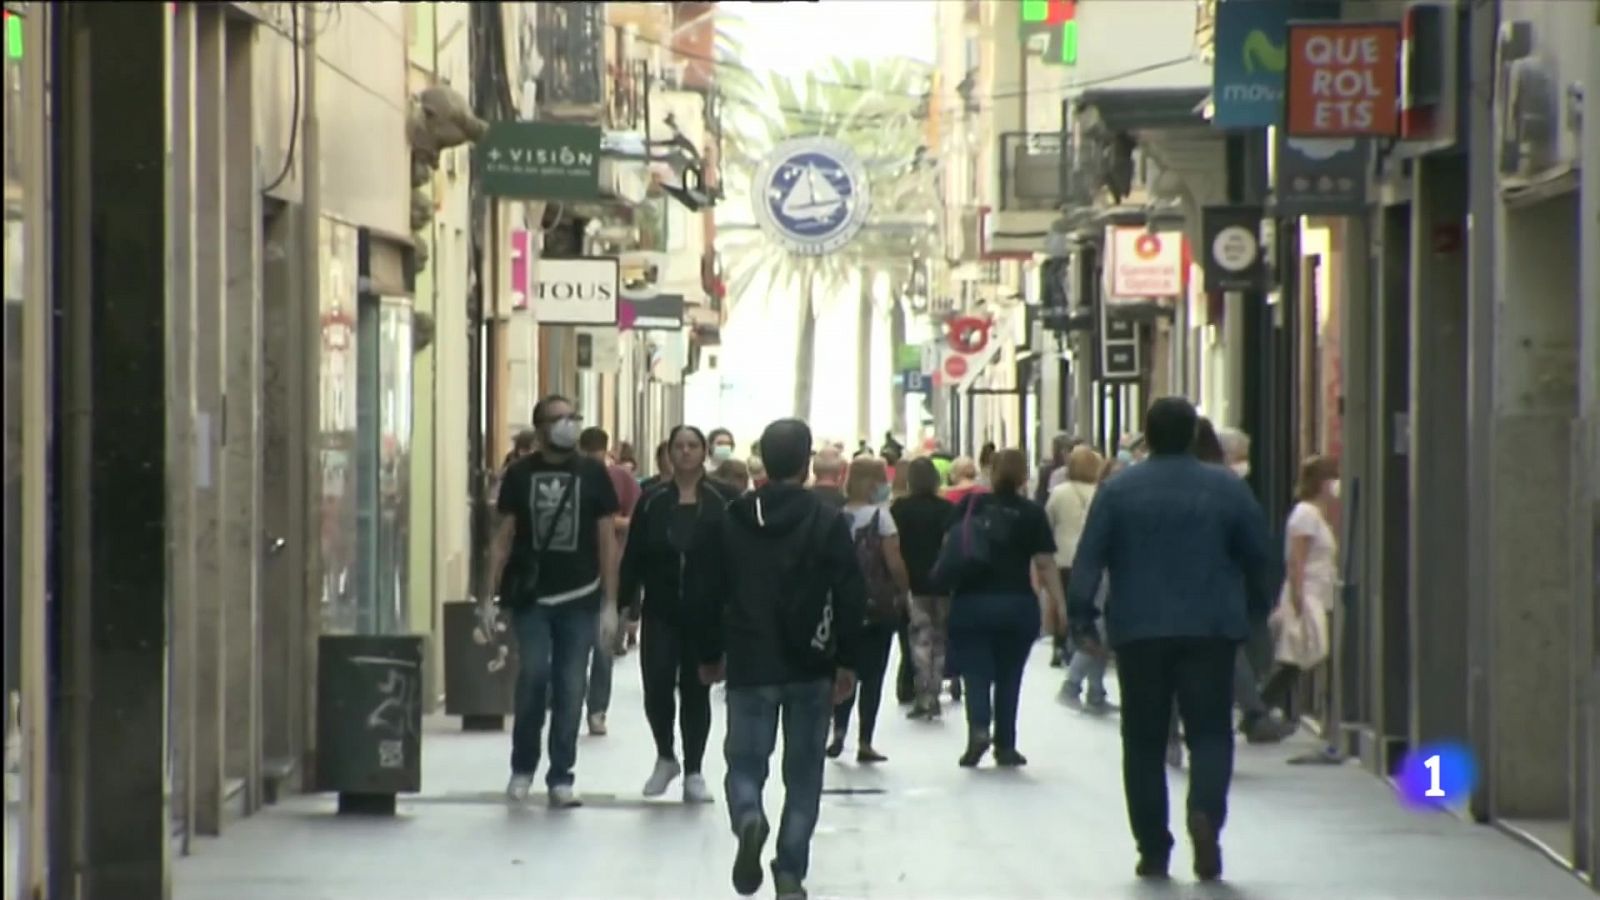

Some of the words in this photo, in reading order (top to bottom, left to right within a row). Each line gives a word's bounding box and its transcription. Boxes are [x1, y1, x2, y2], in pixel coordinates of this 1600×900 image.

[1305, 35, 1378, 65] QUE
[1312, 69, 1381, 96] ROL
[1313, 101, 1372, 128] ETS
[509, 145, 593, 166] VISIÓN
